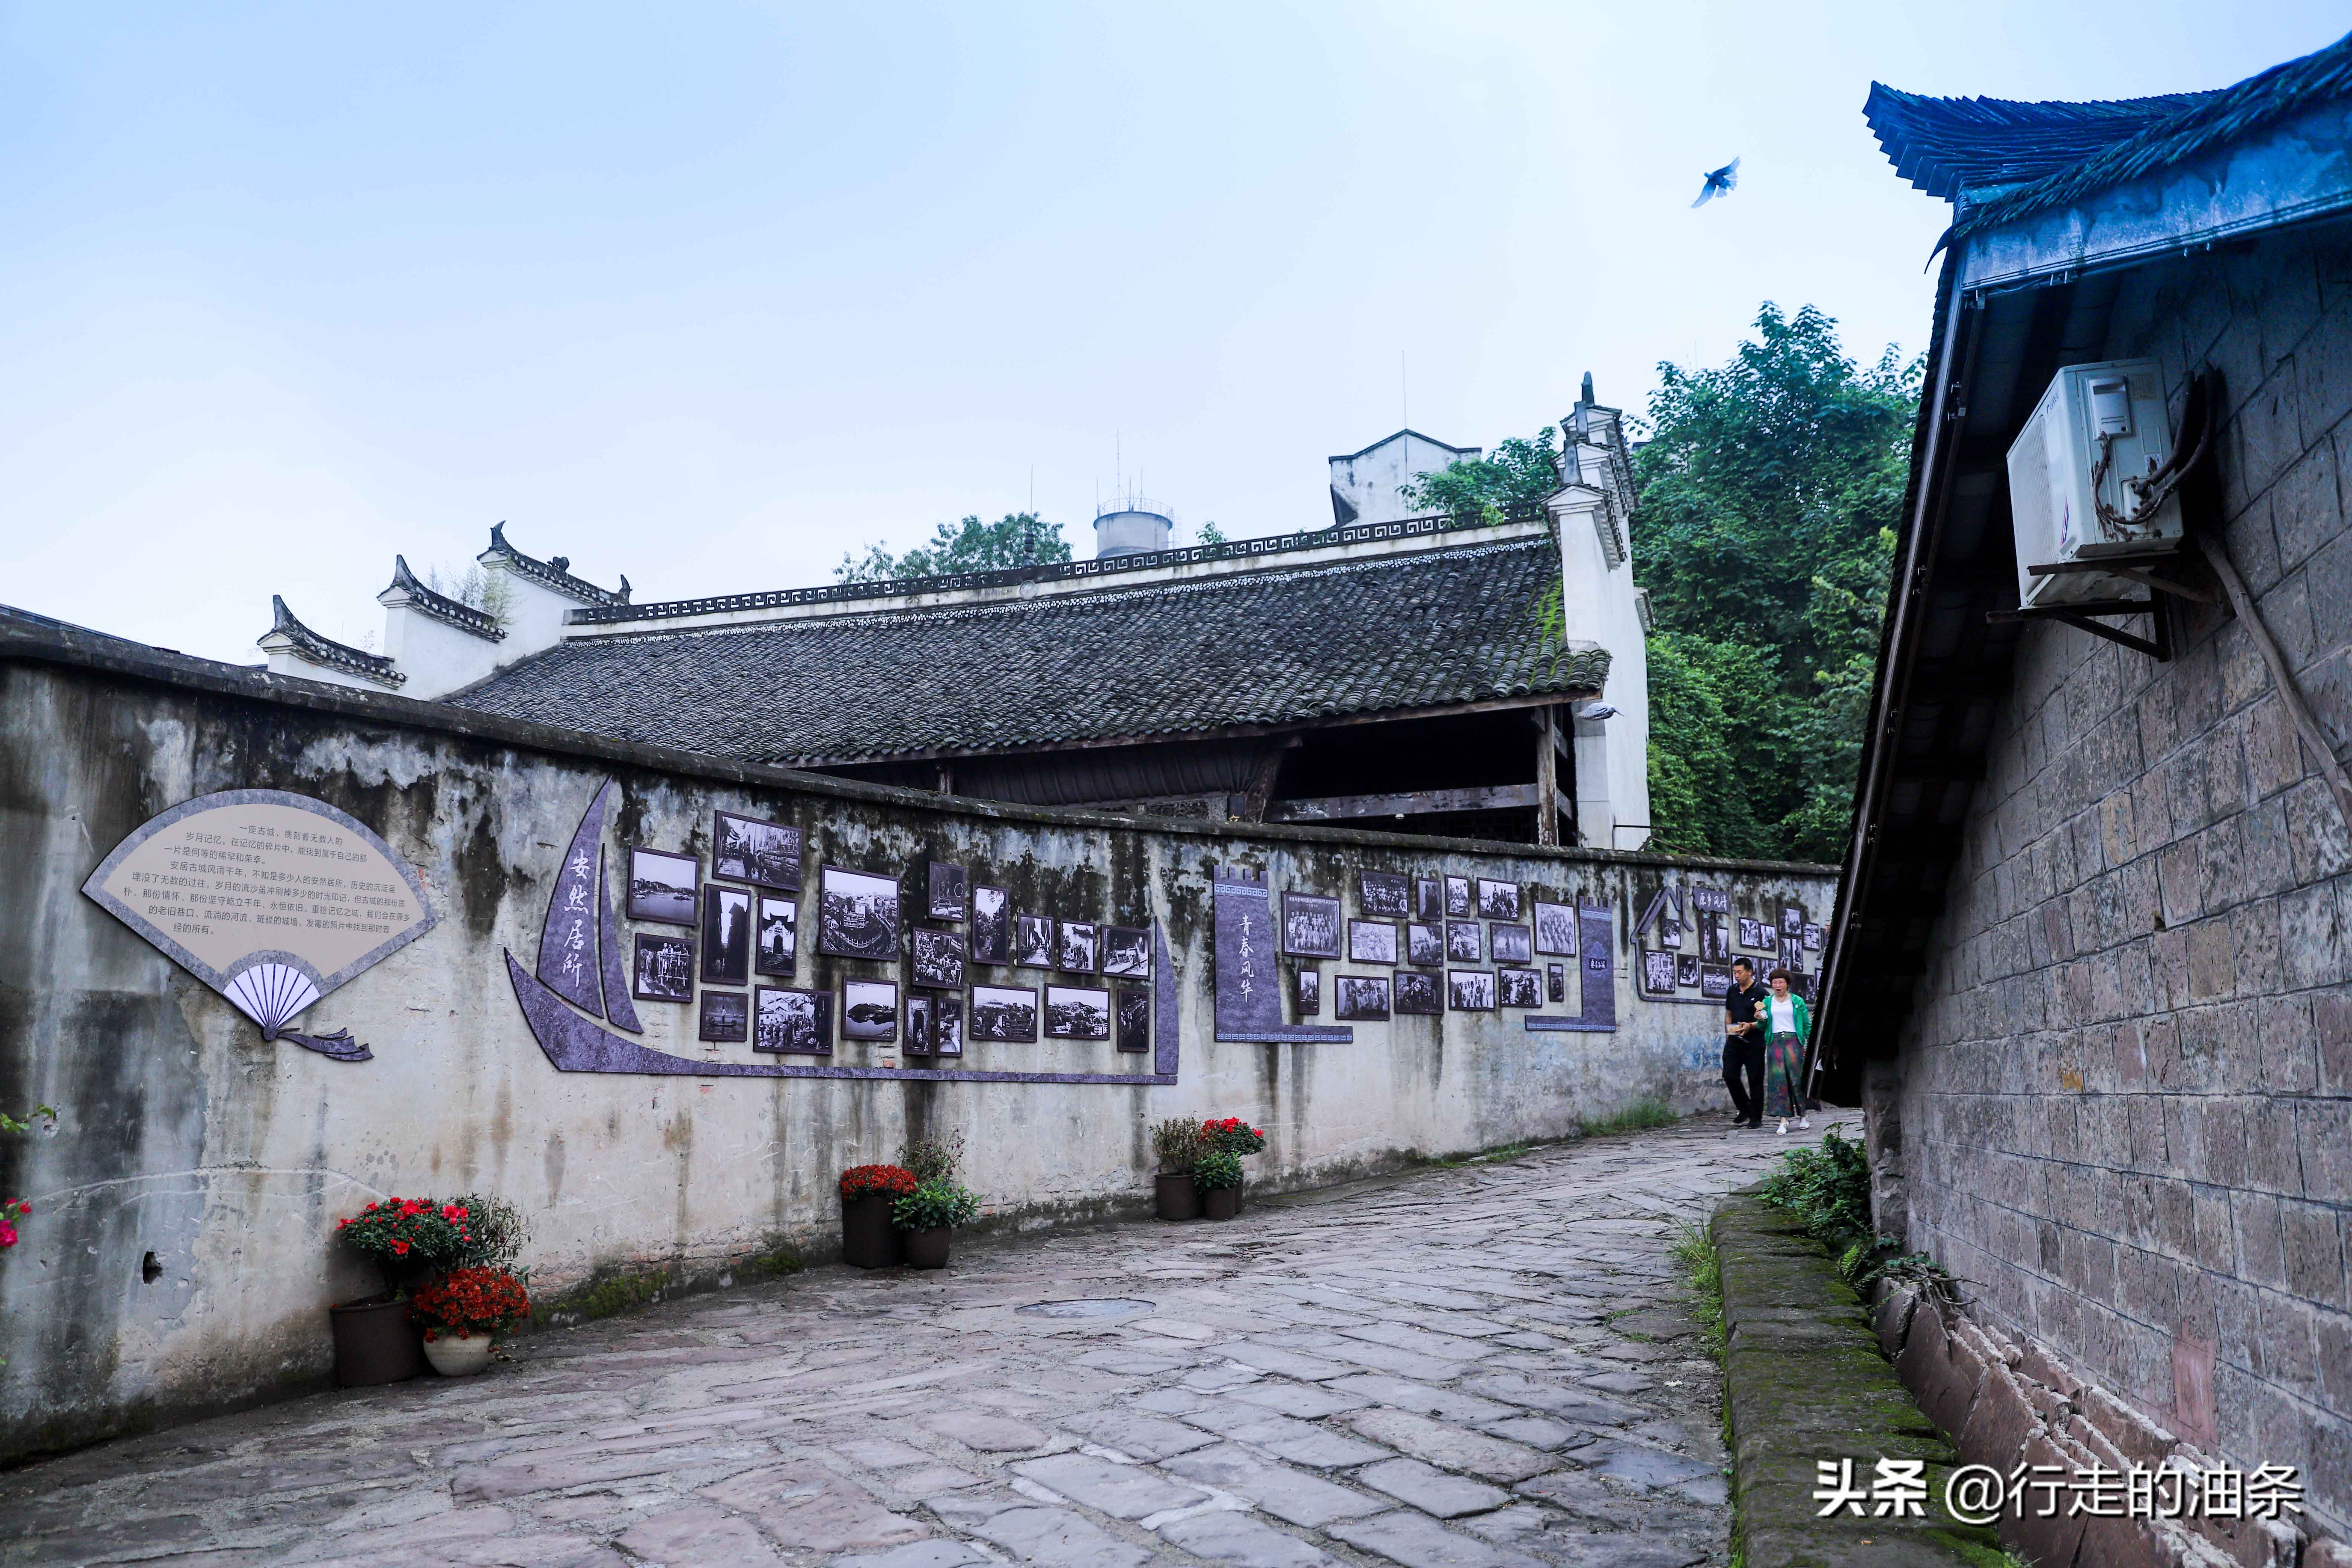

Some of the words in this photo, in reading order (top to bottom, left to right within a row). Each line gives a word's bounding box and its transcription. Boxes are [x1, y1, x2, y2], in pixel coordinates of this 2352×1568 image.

[173, 922, 215, 935] 经的所有。
[563, 848, 590, 987] 安然居所
[1239, 914, 1254, 1002] 青春风华
